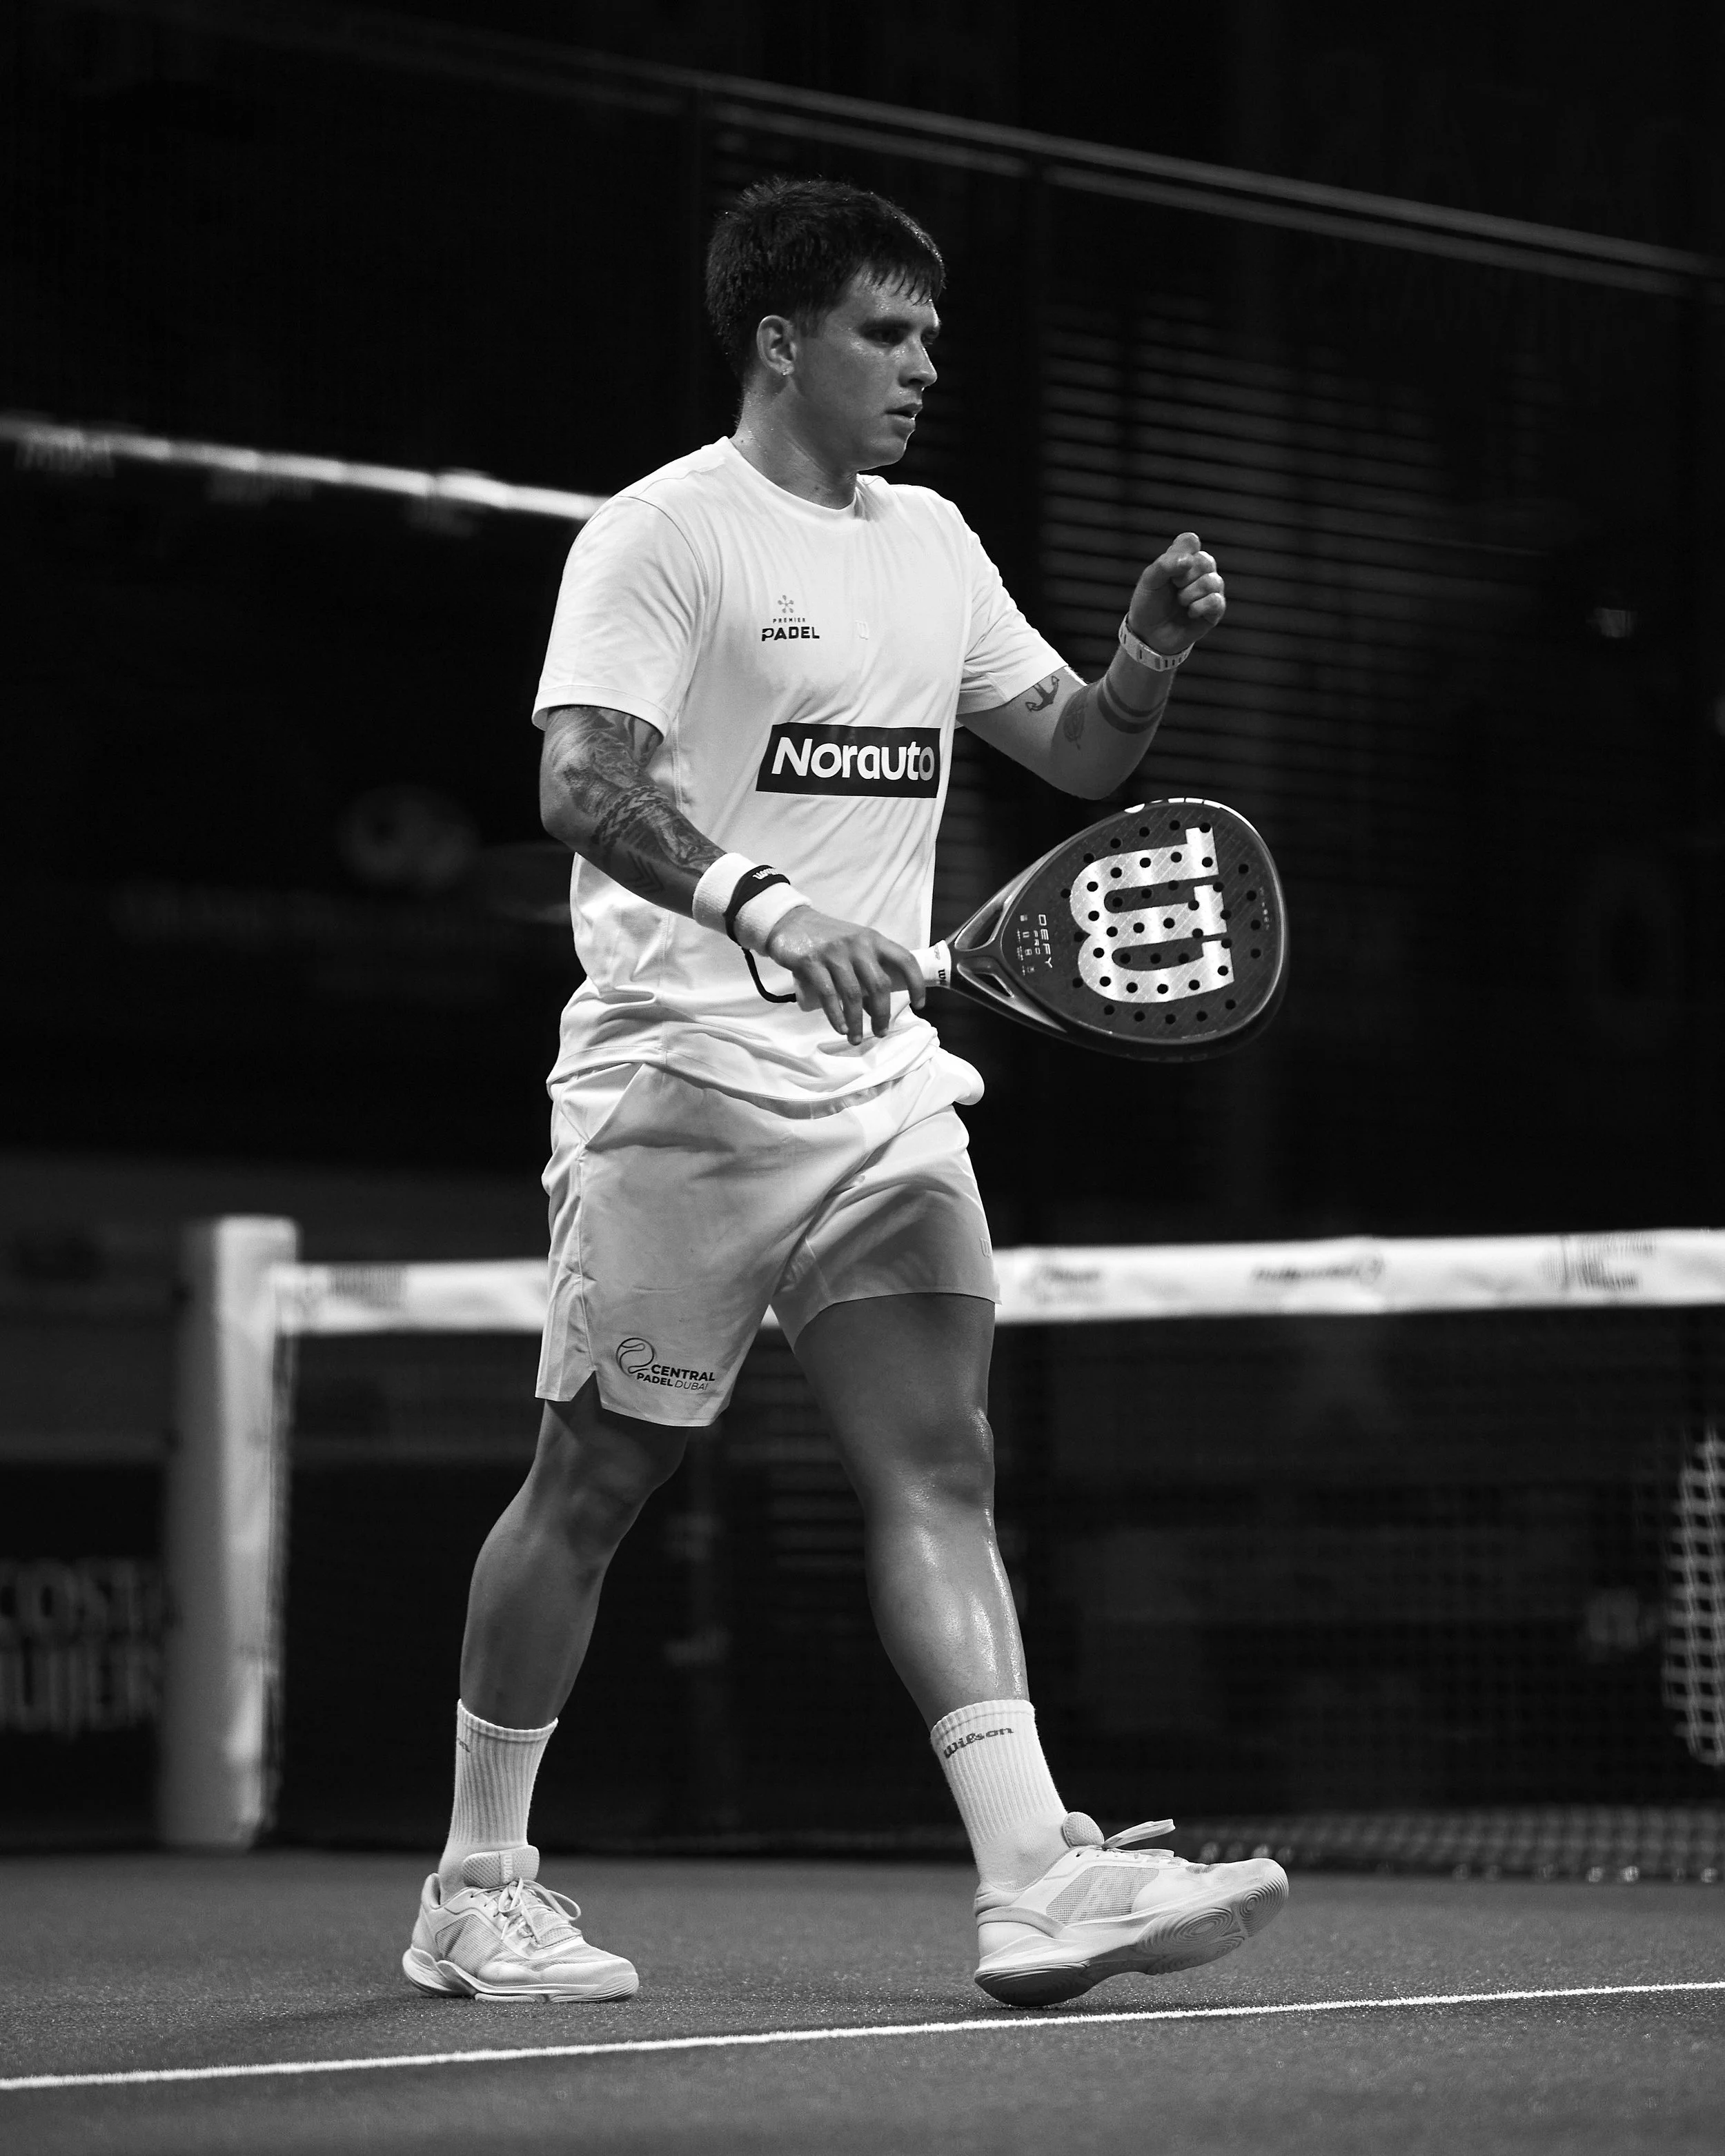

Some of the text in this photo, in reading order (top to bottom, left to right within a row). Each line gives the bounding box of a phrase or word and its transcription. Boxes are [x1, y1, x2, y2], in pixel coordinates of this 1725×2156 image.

[761, 626, 820, 642] PADEL
[771, 736, 935, 781] Norauto
[1038, 913, 1053, 969] DEFY
[636, 1372, 709, 1391] PADEL DUBAI
[651, 1364, 716, 1382] CENTRAL
[943, 1727, 1014, 1759] Wilson
